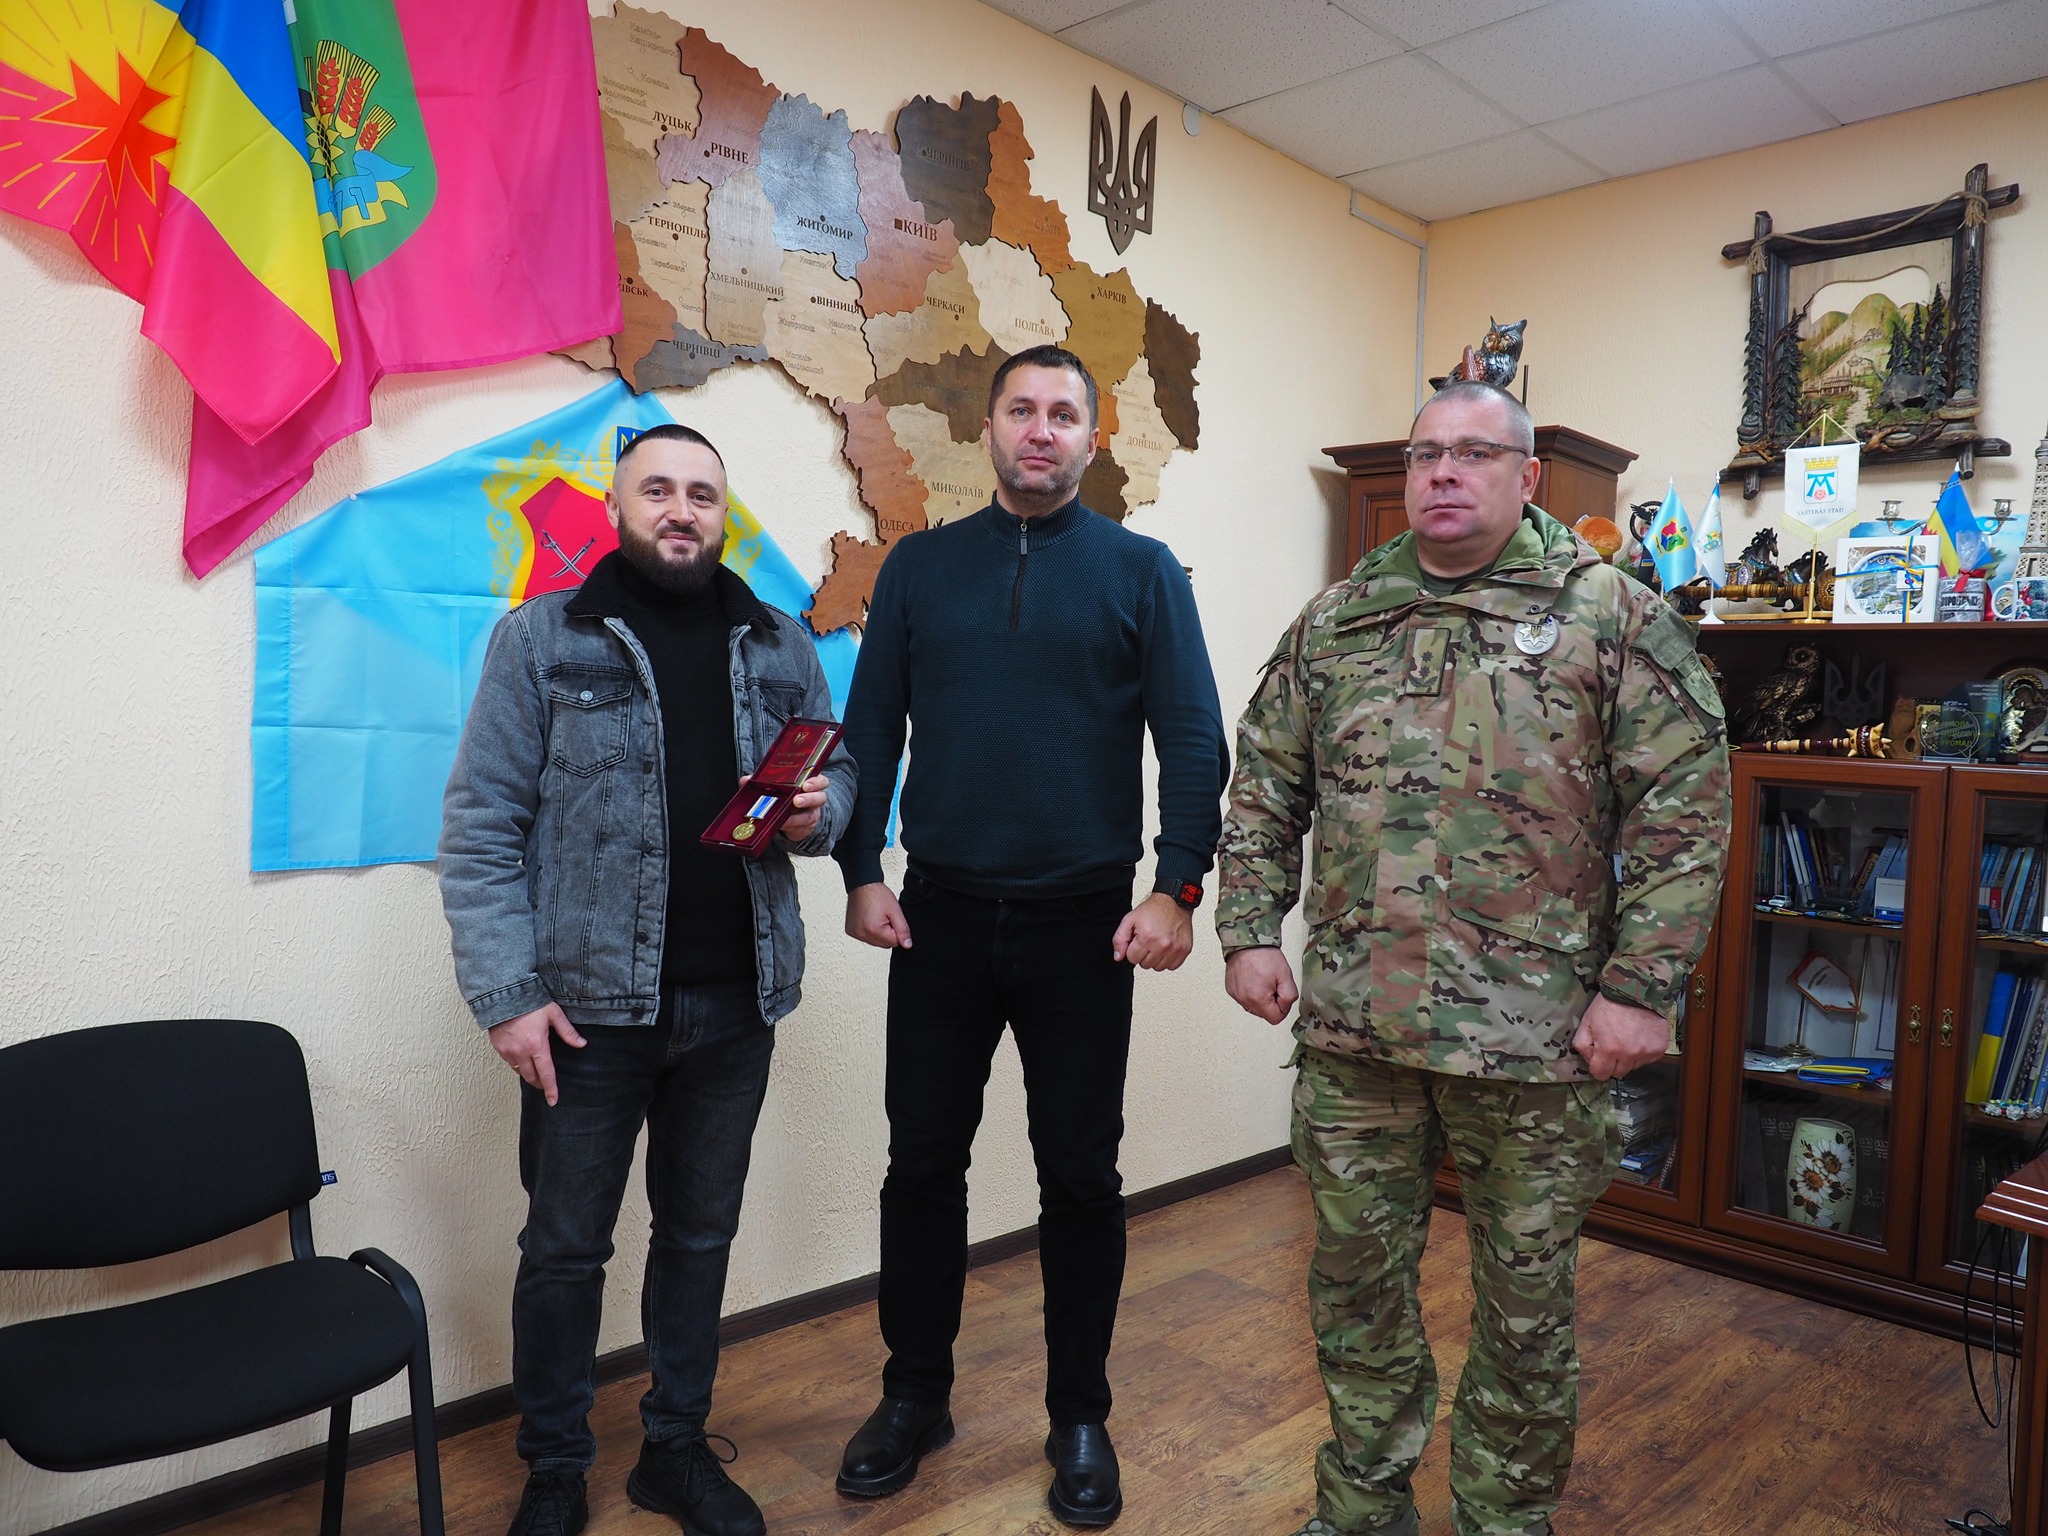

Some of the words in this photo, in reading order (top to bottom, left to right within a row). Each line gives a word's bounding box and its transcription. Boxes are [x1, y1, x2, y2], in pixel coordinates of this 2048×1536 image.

[652, 110, 692, 132] ЛУЦЬК
[710, 142, 749, 164] РІВНЕ
[926, 147, 970, 171] ЧЕРНІГІВ
[648, 215, 706, 239] ТЕРНОПІЛЬ
[796, 215, 854, 241] ЖИТОМИР
[904, 219, 938, 241] КИЇВ
[710, 271, 784, 296] ХМЕЛЬНИЦЬКИЙ
[926, 296, 965, 314] ЧЕРКАСИ
[1097, 286, 1127, 304] ХАРКІВ
[816, 296, 860, 315] ВІННИЦЯ
[1014, 318, 1055, 338] ПОЛТАВА
[673, 340, 721, 359] ЧЕРНІВЦІ
[1126, 436, 1163, 451] ДОНЕЦЬК
[931, 481, 984, 498] МИКОЛАЇВ
[880, 518, 915, 533] ОДЕСА
